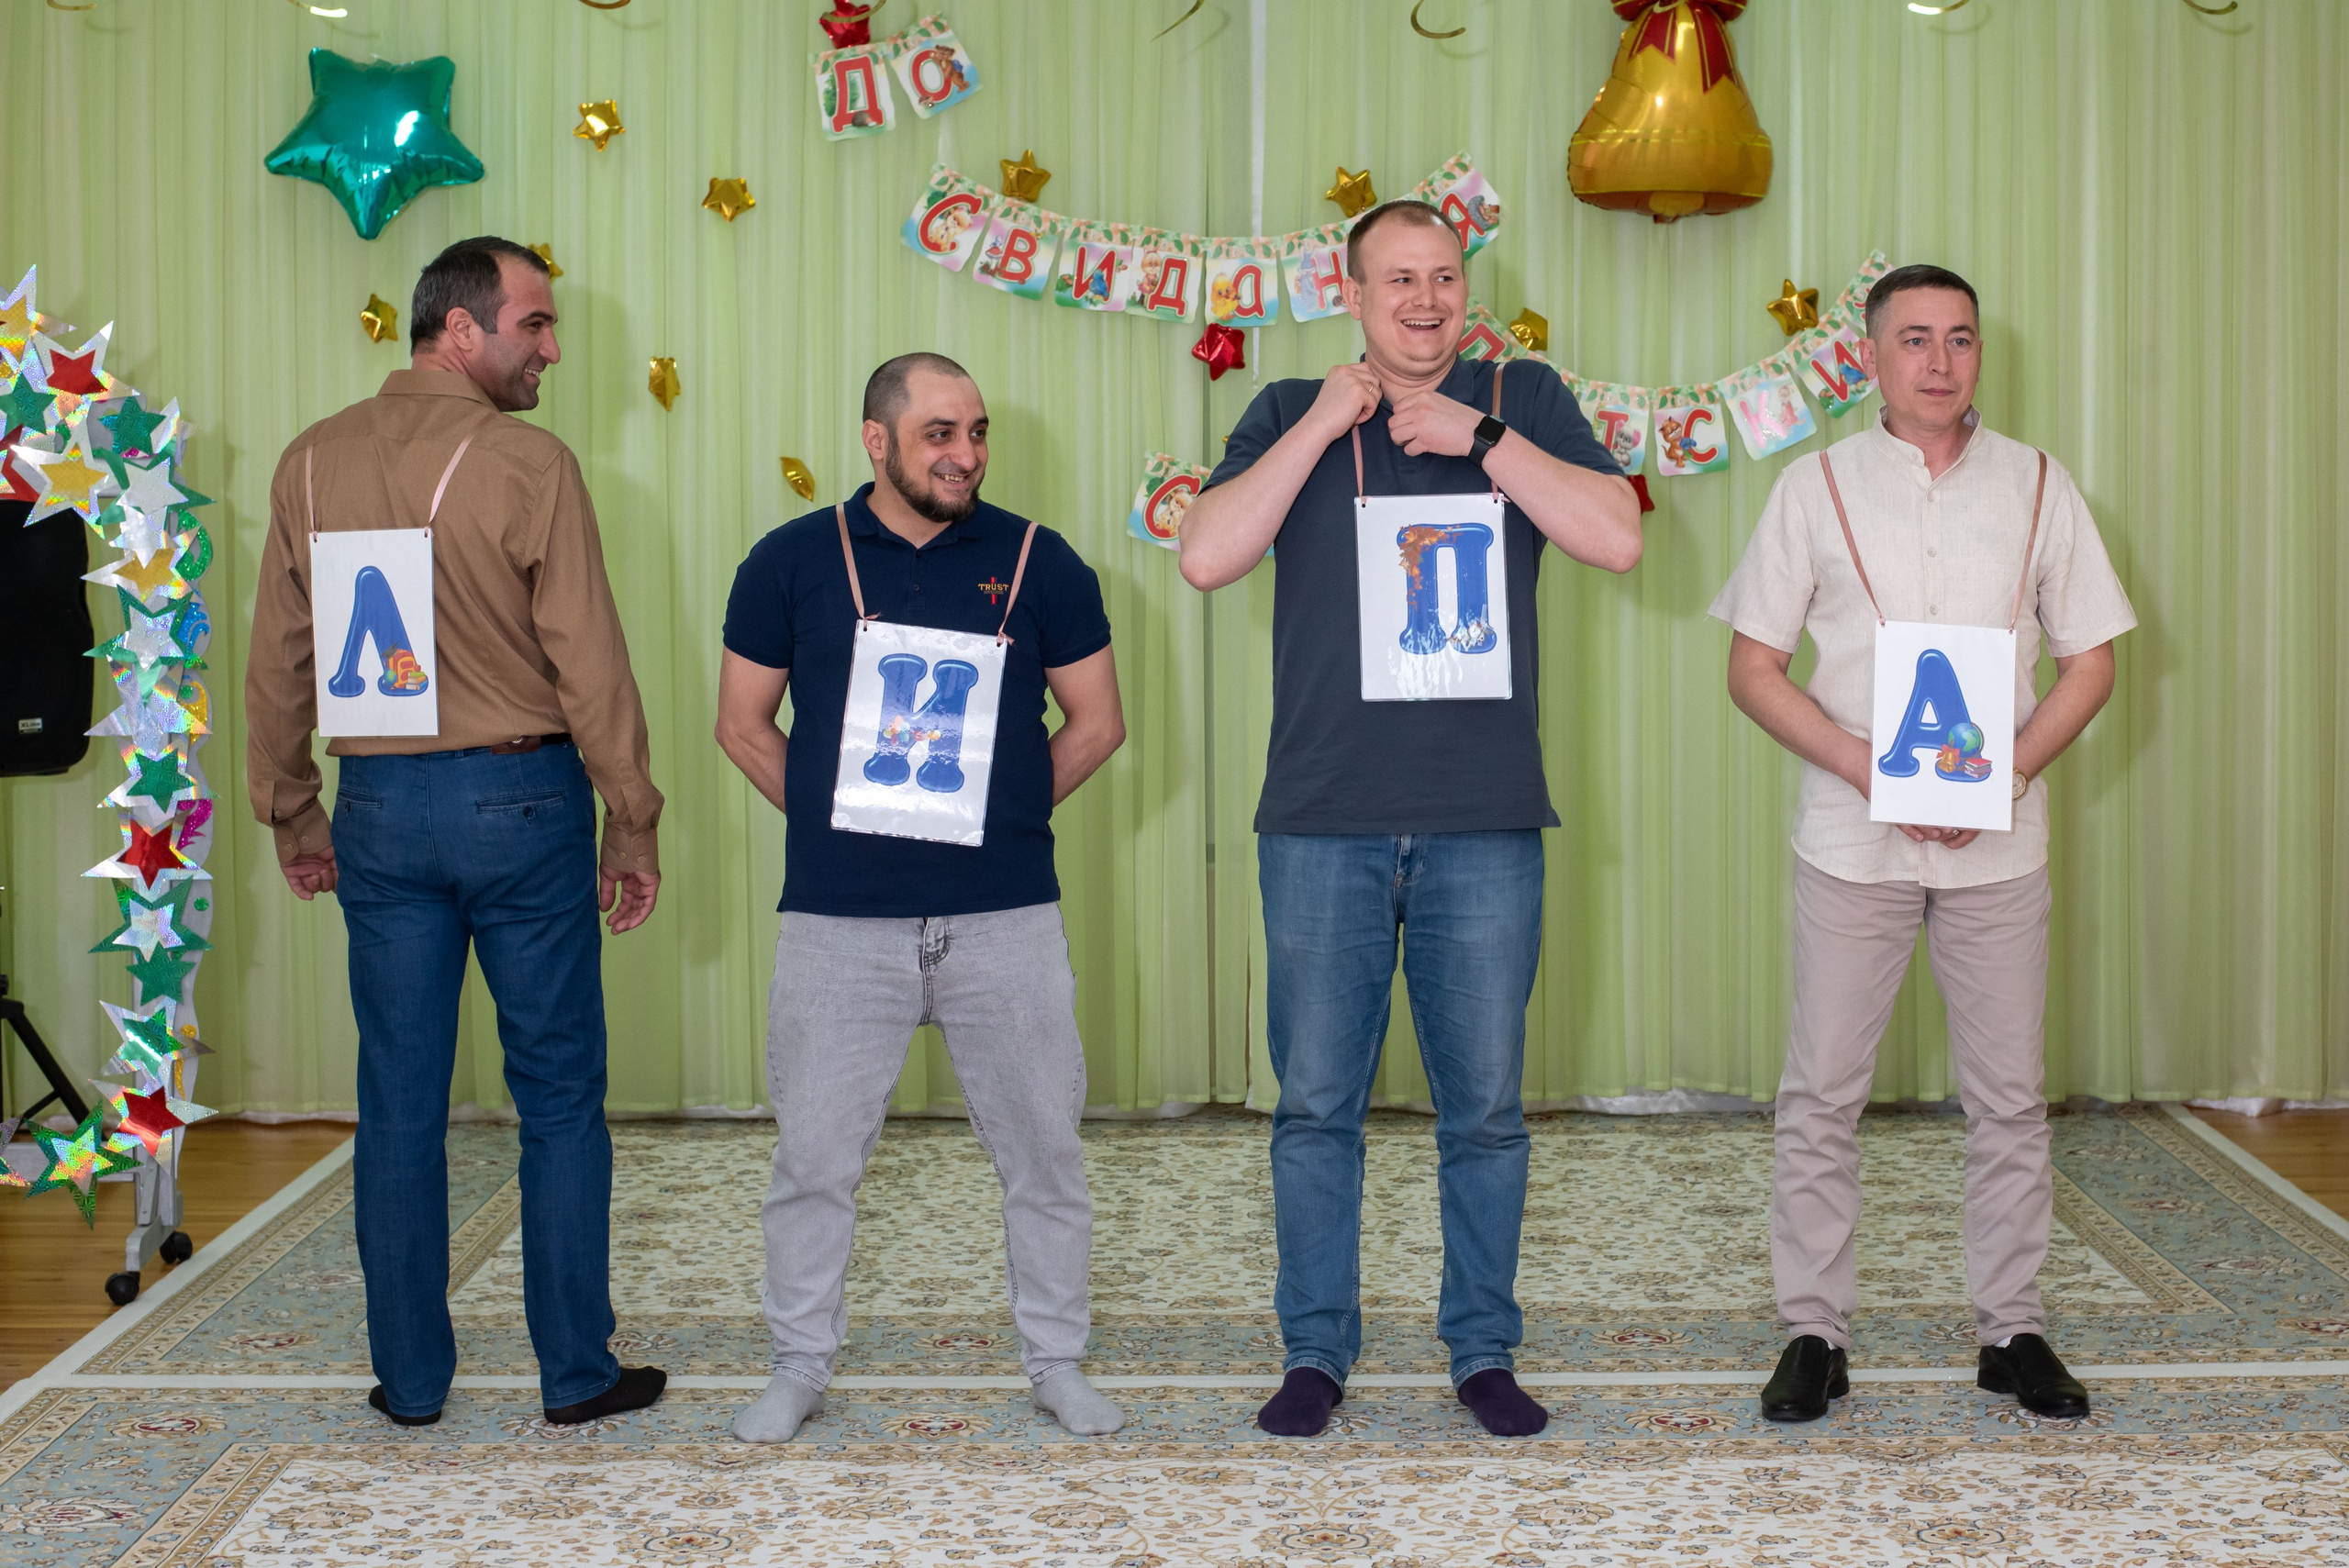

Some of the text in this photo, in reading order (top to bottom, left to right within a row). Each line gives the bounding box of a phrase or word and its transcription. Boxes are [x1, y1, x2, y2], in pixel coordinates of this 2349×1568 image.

[832, 50, 952, 133] ДО
[918, 192, 1486, 318] СВИДАНЯ
[328, 565, 429, 697] Л
[978, 583, 1009, 592] TRUST
[1397, 523, 1497, 655] П
[863, 653, 978, 793] И
[1878, 649, 1992, 783] А
